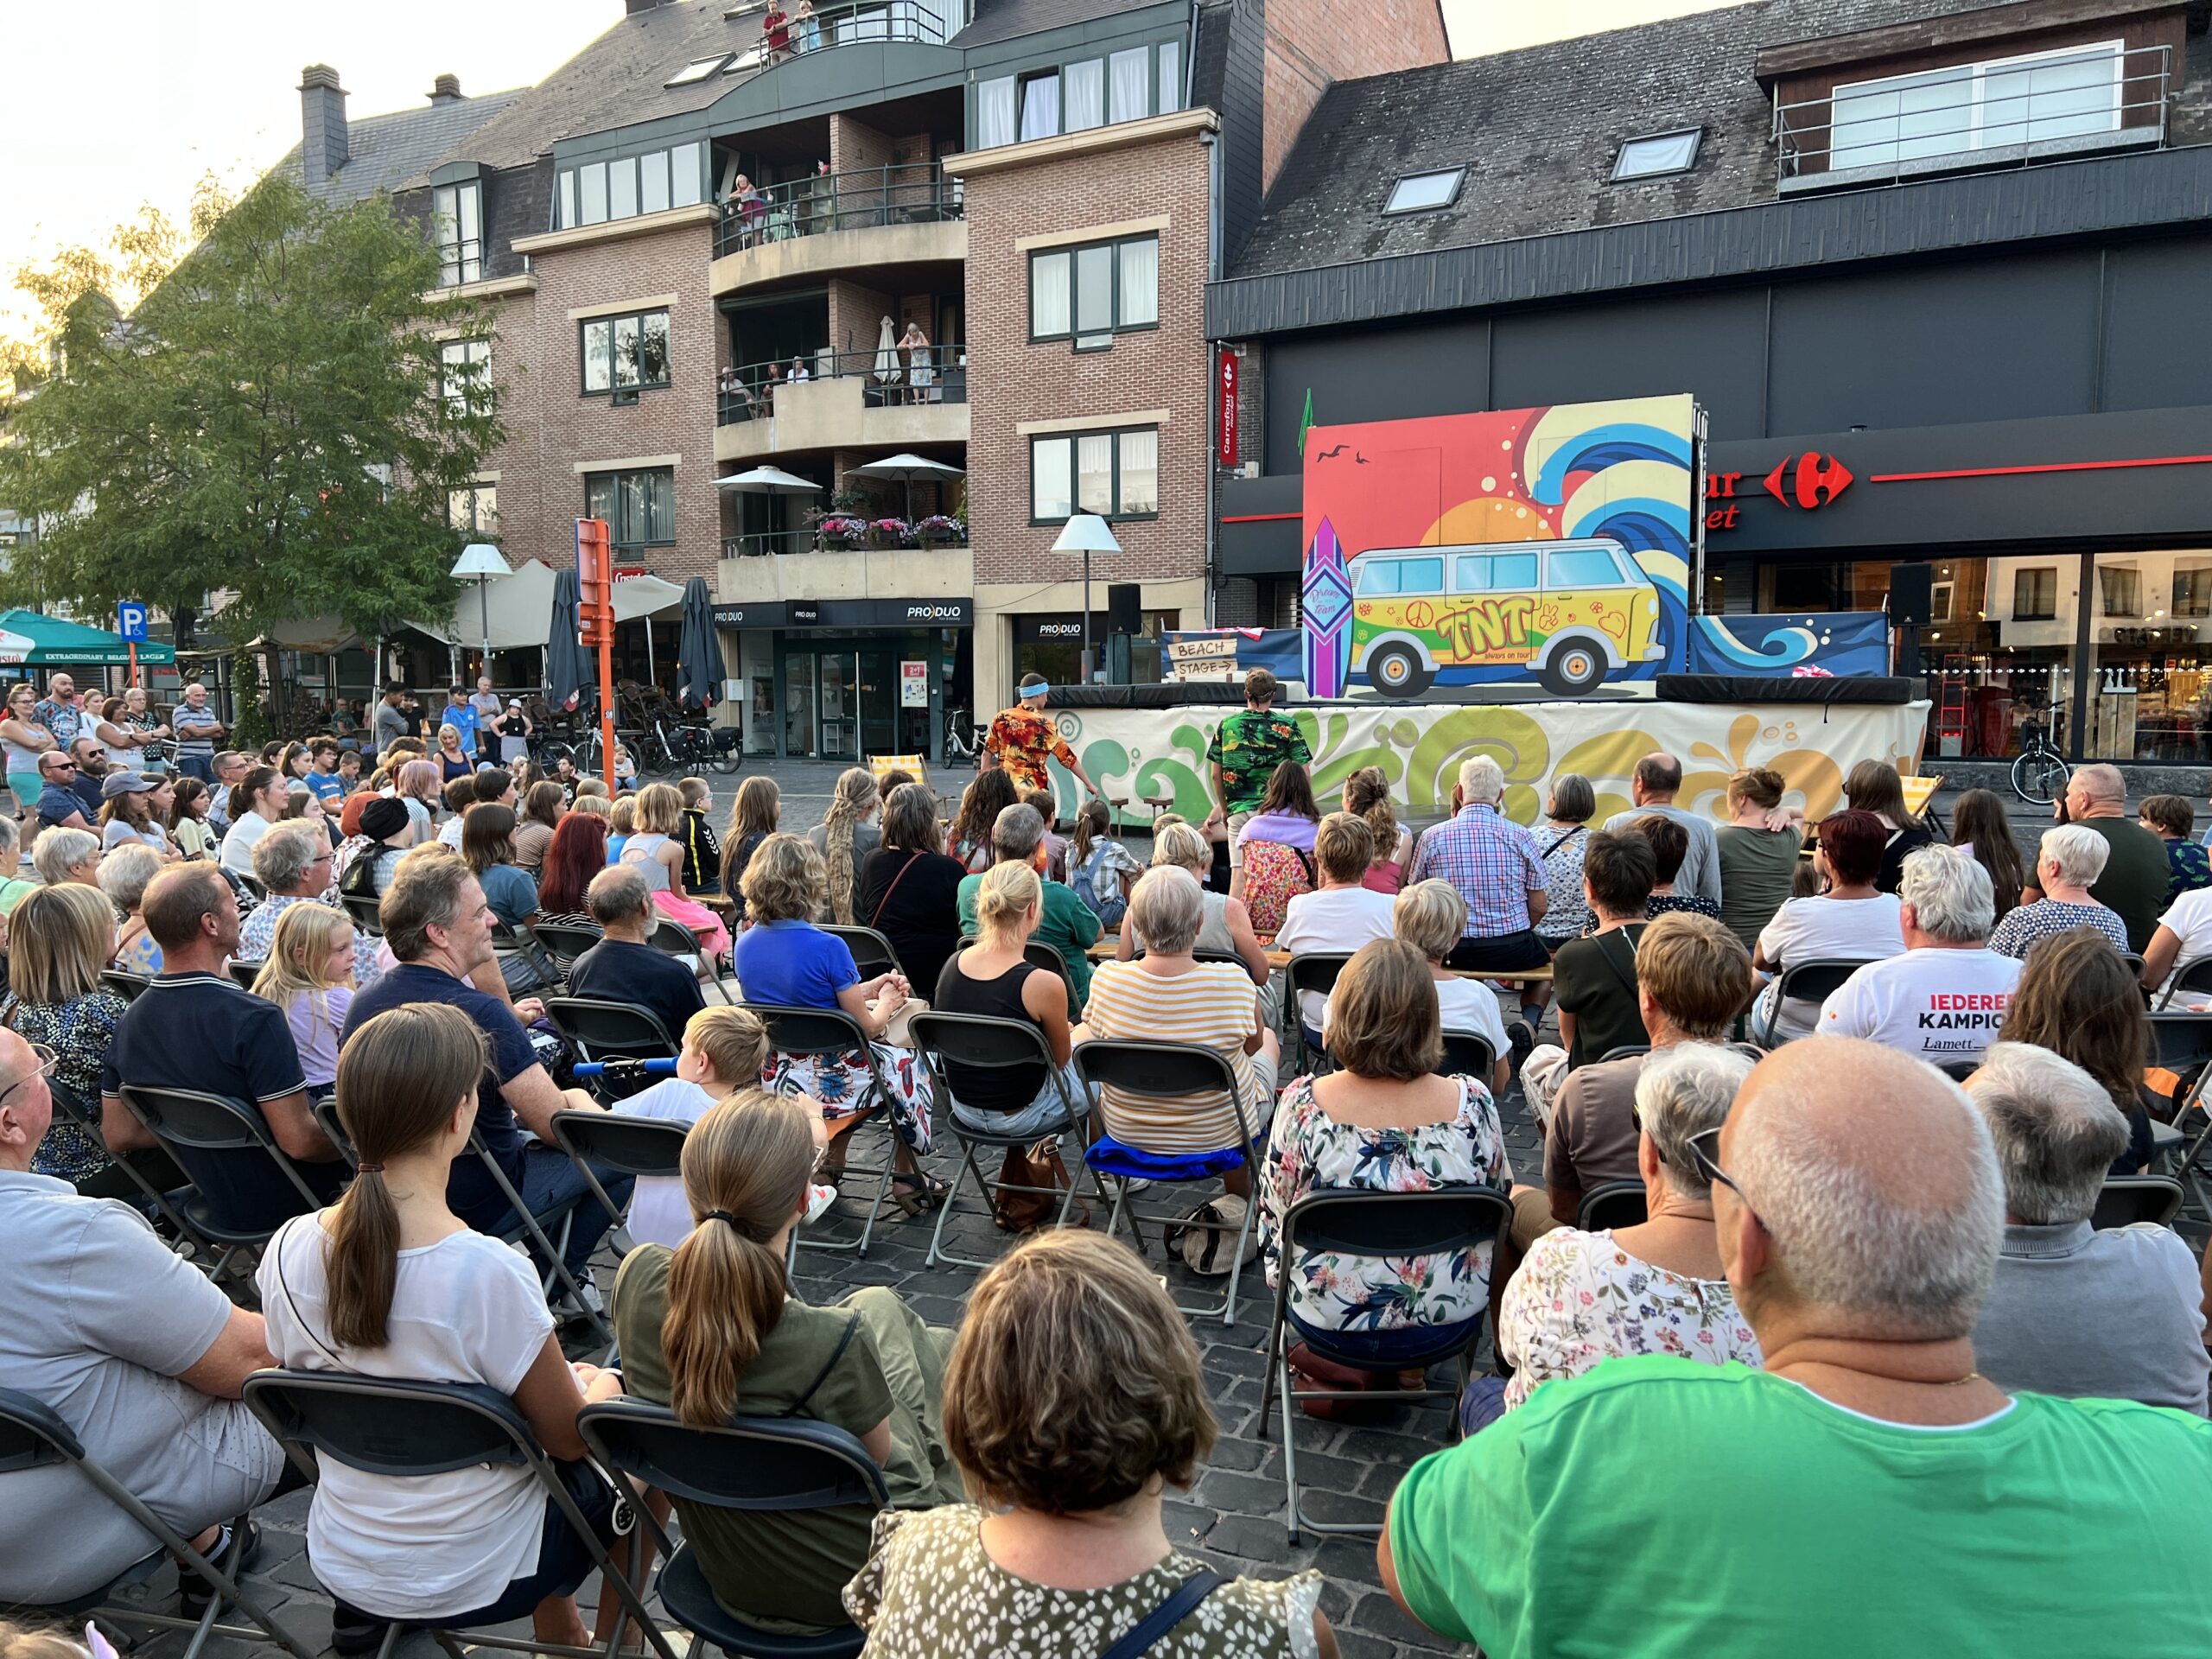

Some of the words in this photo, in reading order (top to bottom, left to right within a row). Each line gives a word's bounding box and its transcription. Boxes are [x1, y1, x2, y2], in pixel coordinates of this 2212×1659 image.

[1310, 588, 1340, 603] Dream
[124, 608, 143, 636] P
[1435, 595, 1535, 661] TNT
[1178, 641, 1224, 657] BEACH
[1179, 662, 1217, 674] STAGE
[1923, 1037, 1974, 1049] Lamett
